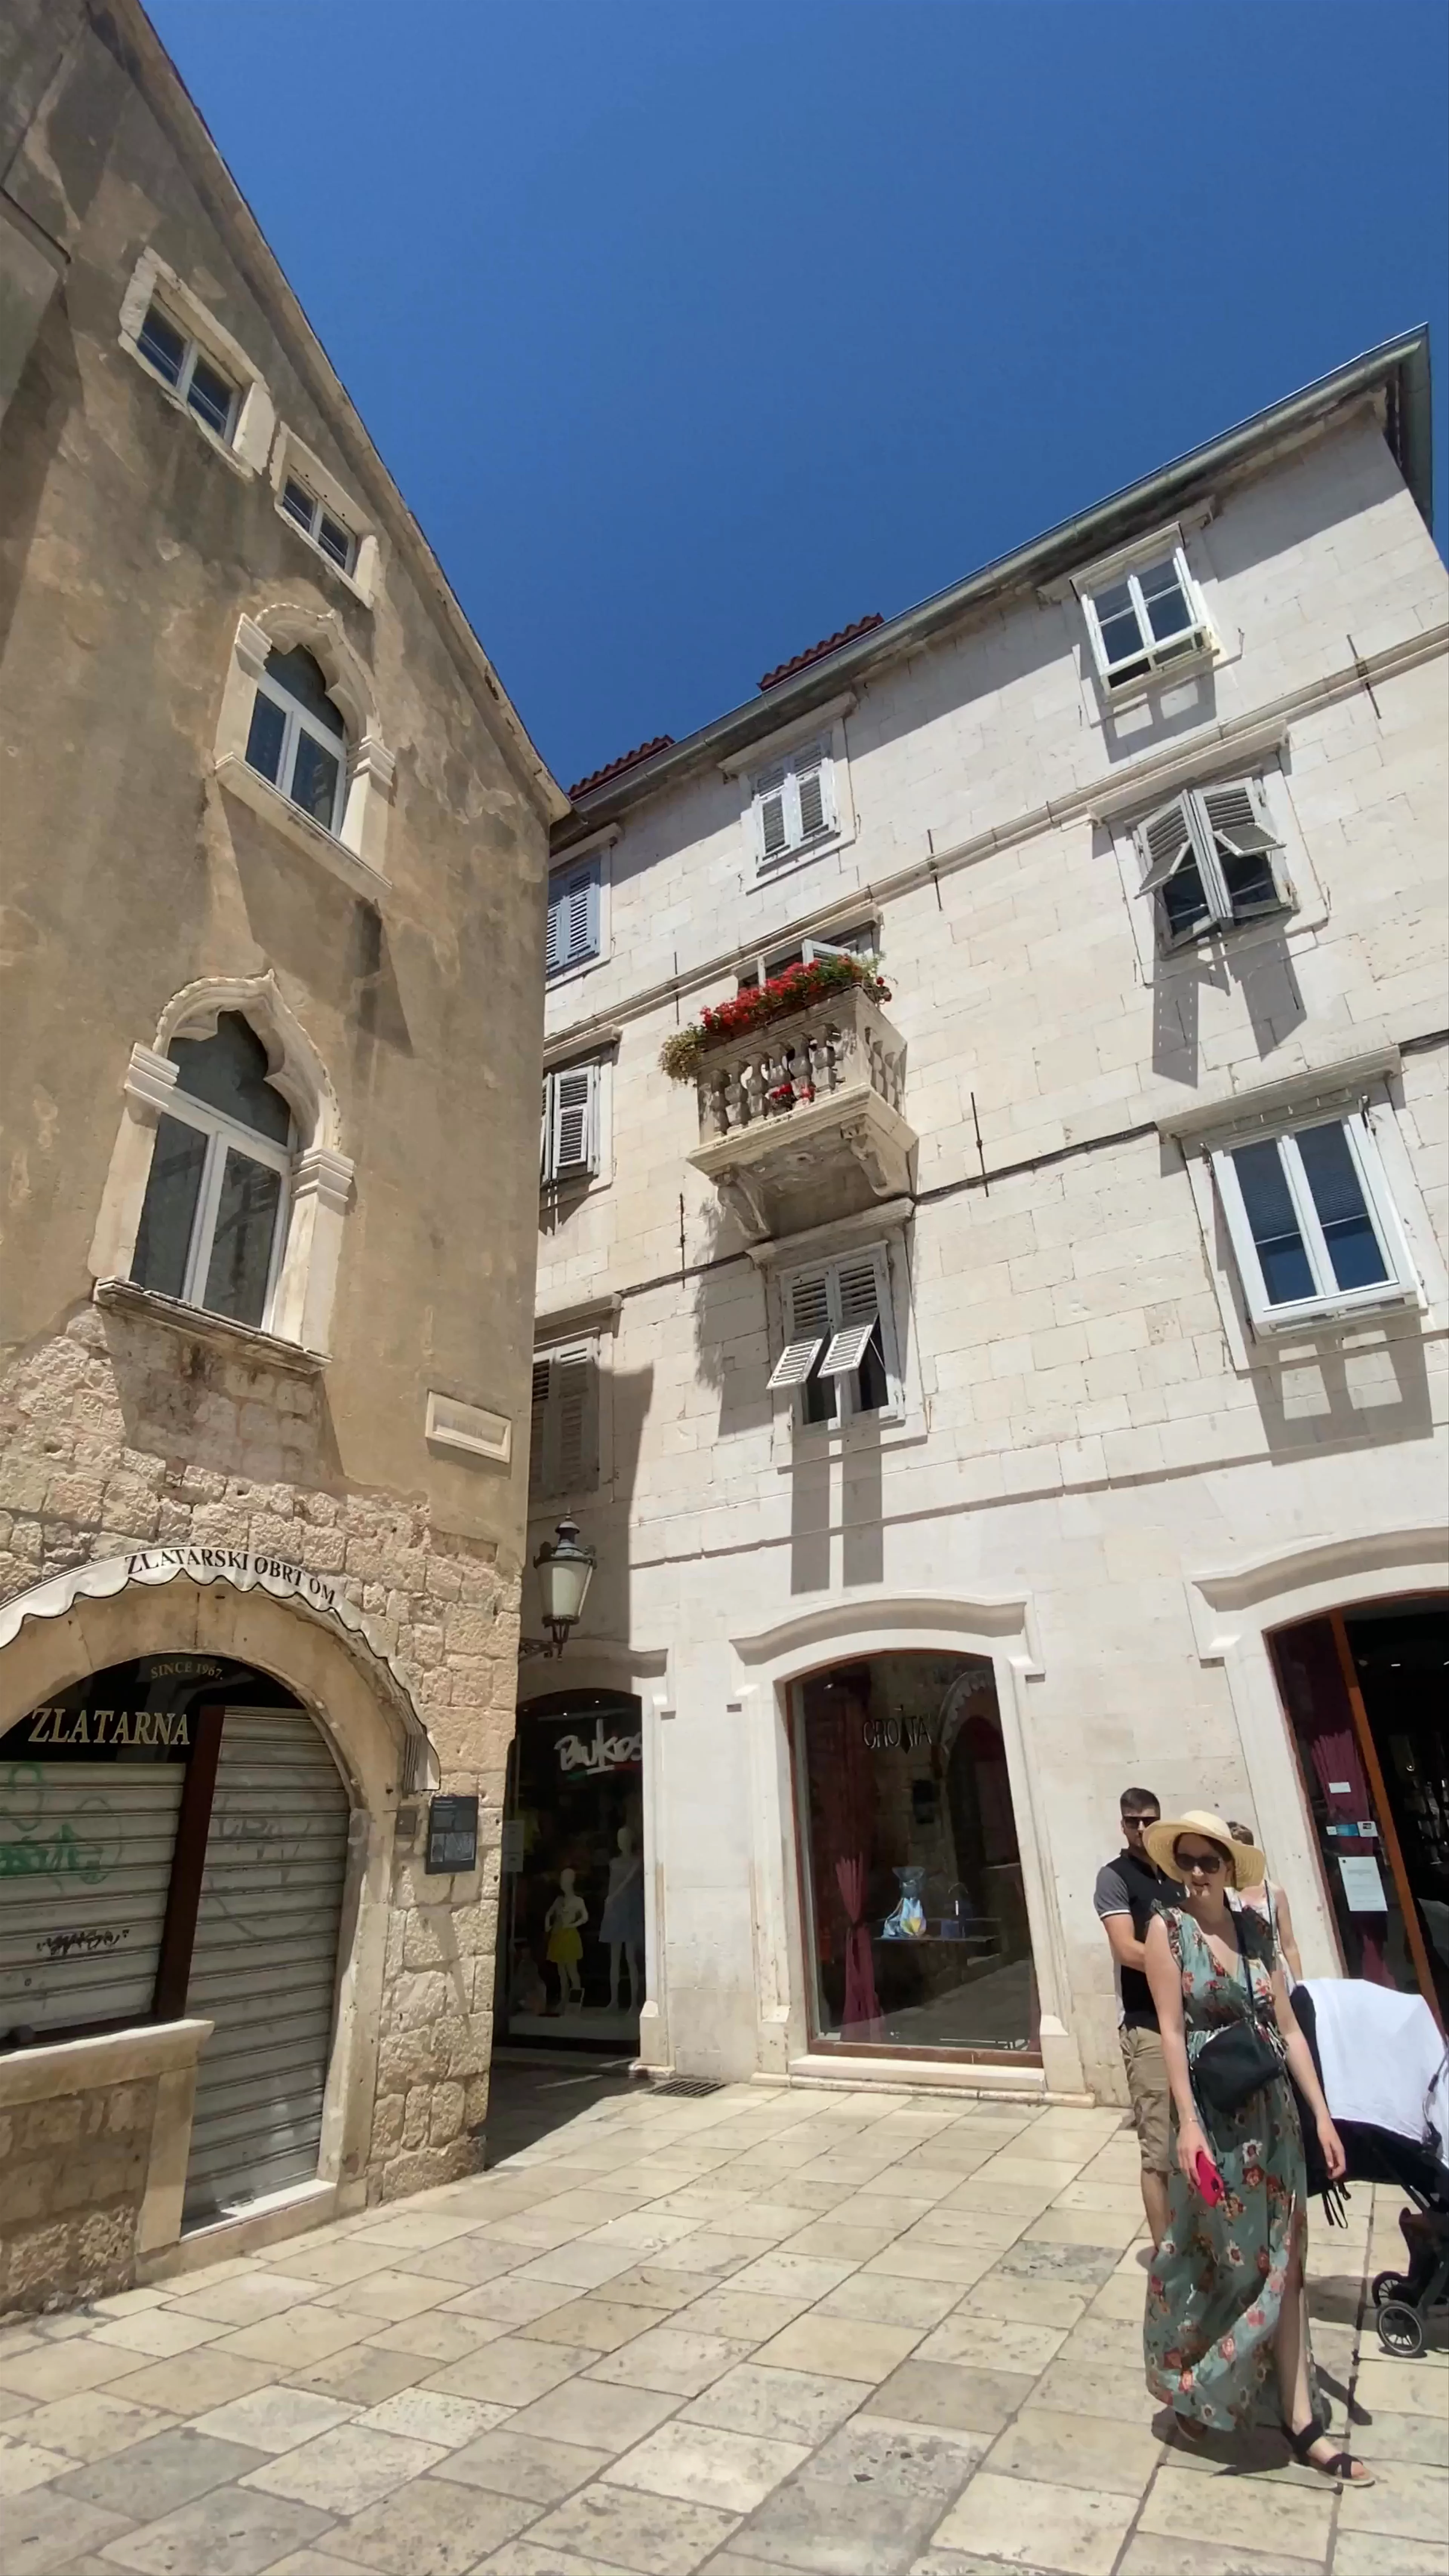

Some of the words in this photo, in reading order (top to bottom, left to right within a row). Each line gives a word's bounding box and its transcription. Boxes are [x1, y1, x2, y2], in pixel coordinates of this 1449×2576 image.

[125, 1549, 250, 1574] ZLATARSKI
[254, 1557, 301, 1587] OBRT
[309, 1578, 335, 1604] OM
[151, 1661, 193, 1679] SINCE
[28, 1708, 191, 1745] ZLATARNA
